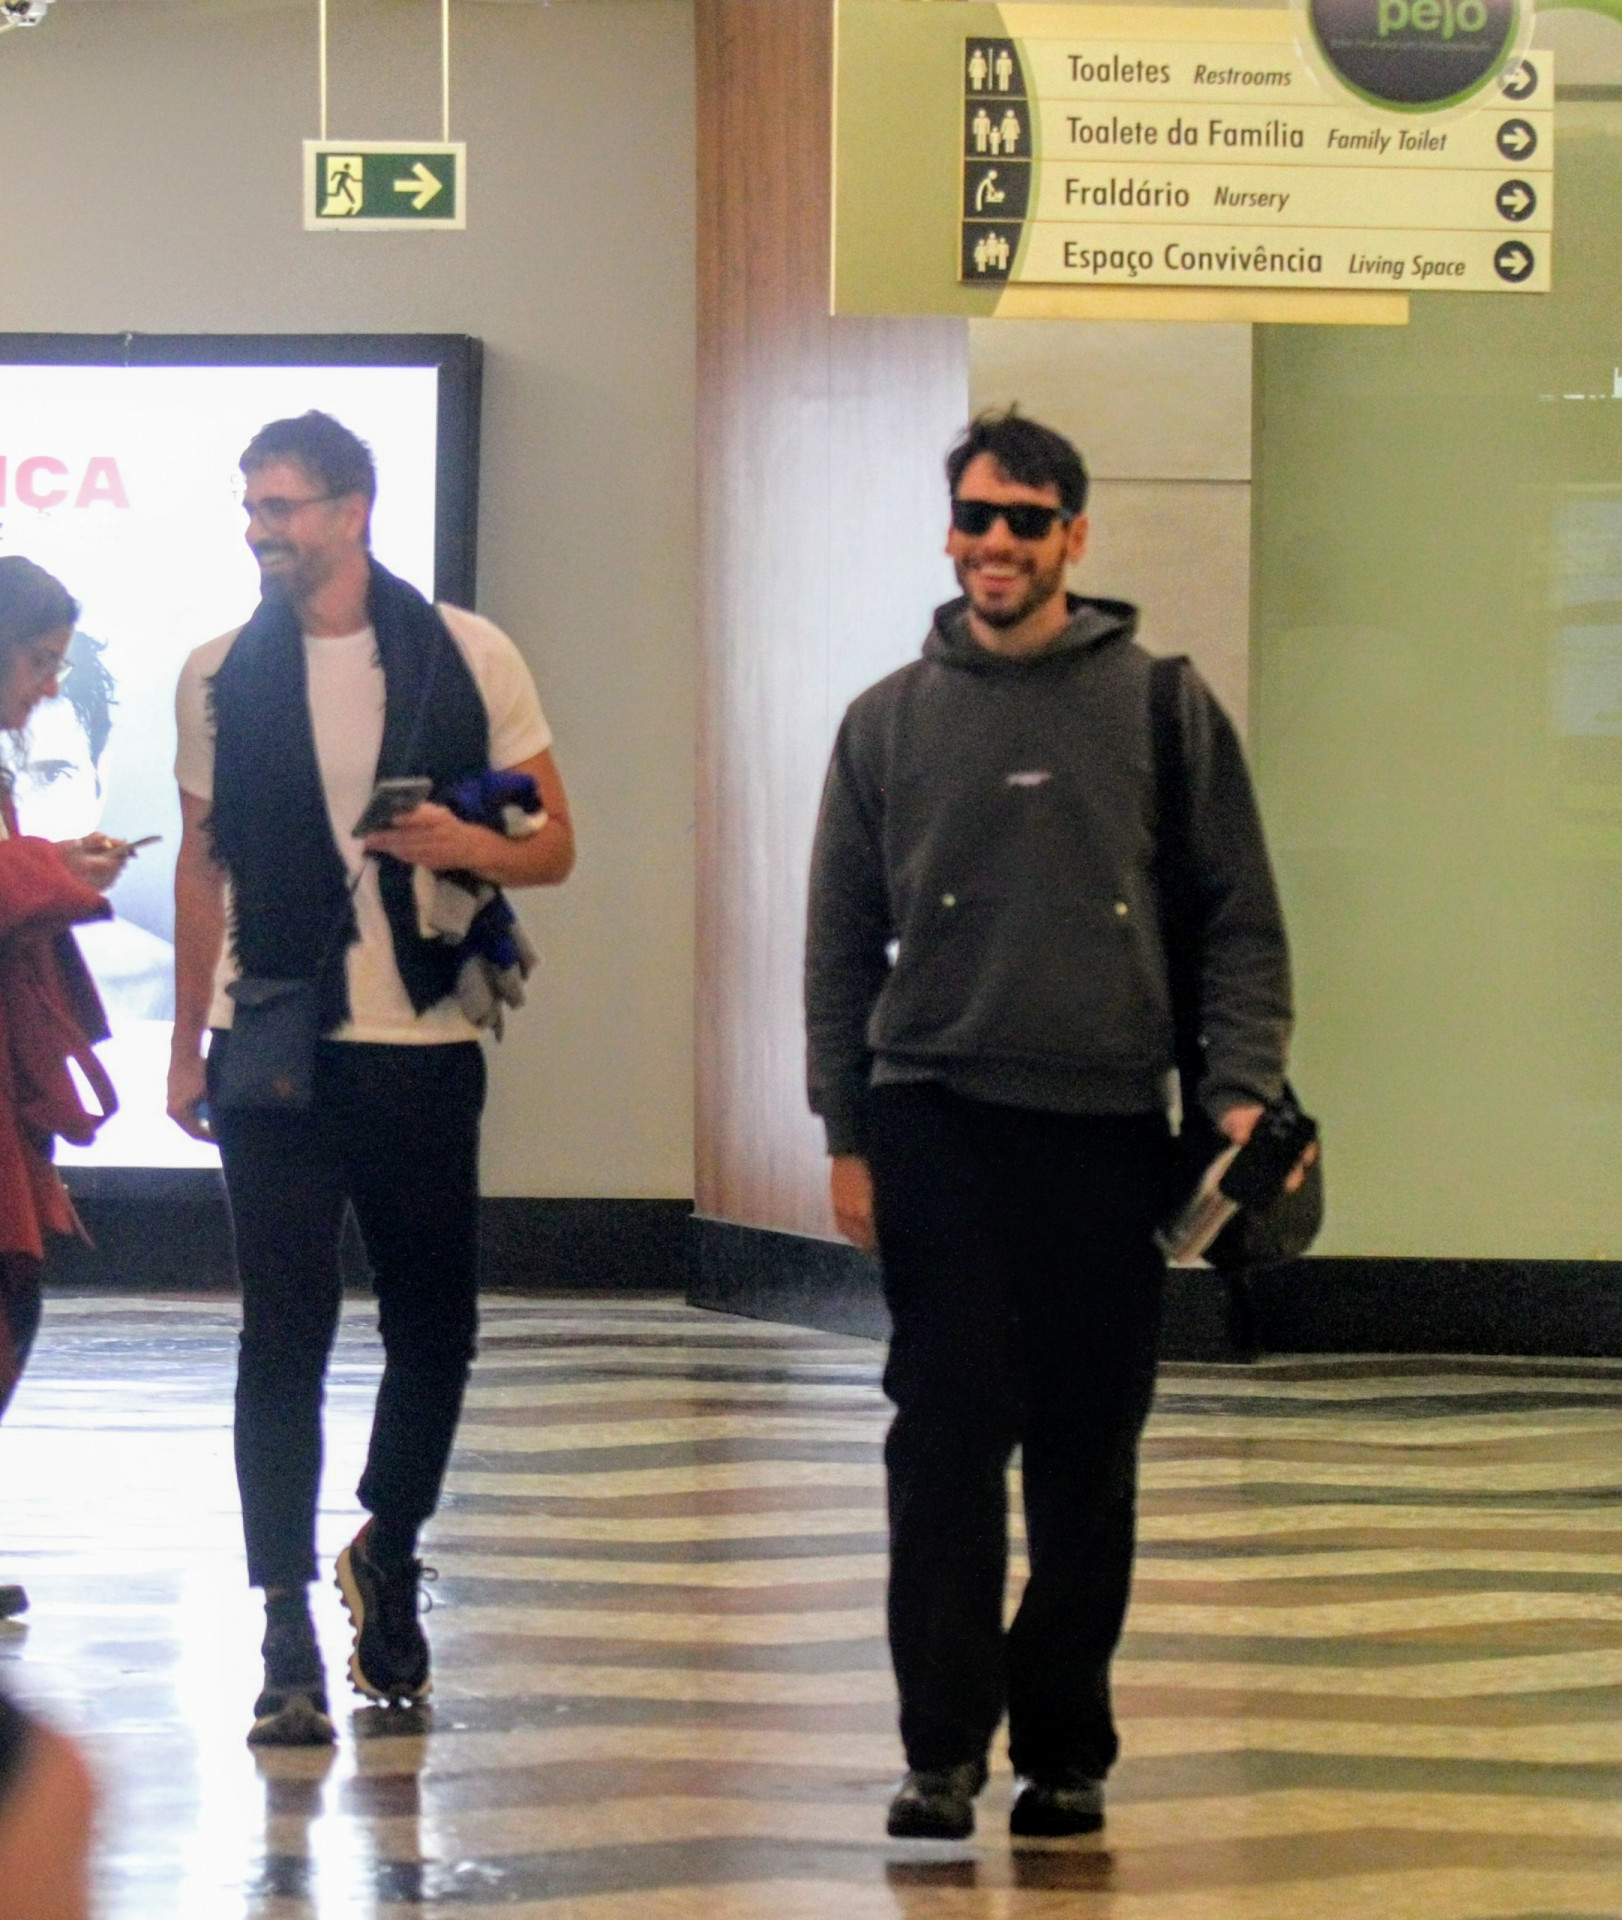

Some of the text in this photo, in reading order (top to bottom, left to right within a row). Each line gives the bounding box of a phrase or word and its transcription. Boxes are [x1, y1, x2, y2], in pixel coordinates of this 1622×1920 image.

[1068, 54, 1291, 86] Toaletes Restrooms
[1066, 116, 1446, 154] Toalete da Família Family Toilet
[1066, 178, 1290, 212] Fraldário Nursery
[1064, 241, 1466, 280] Espaço Convivência Living Space
